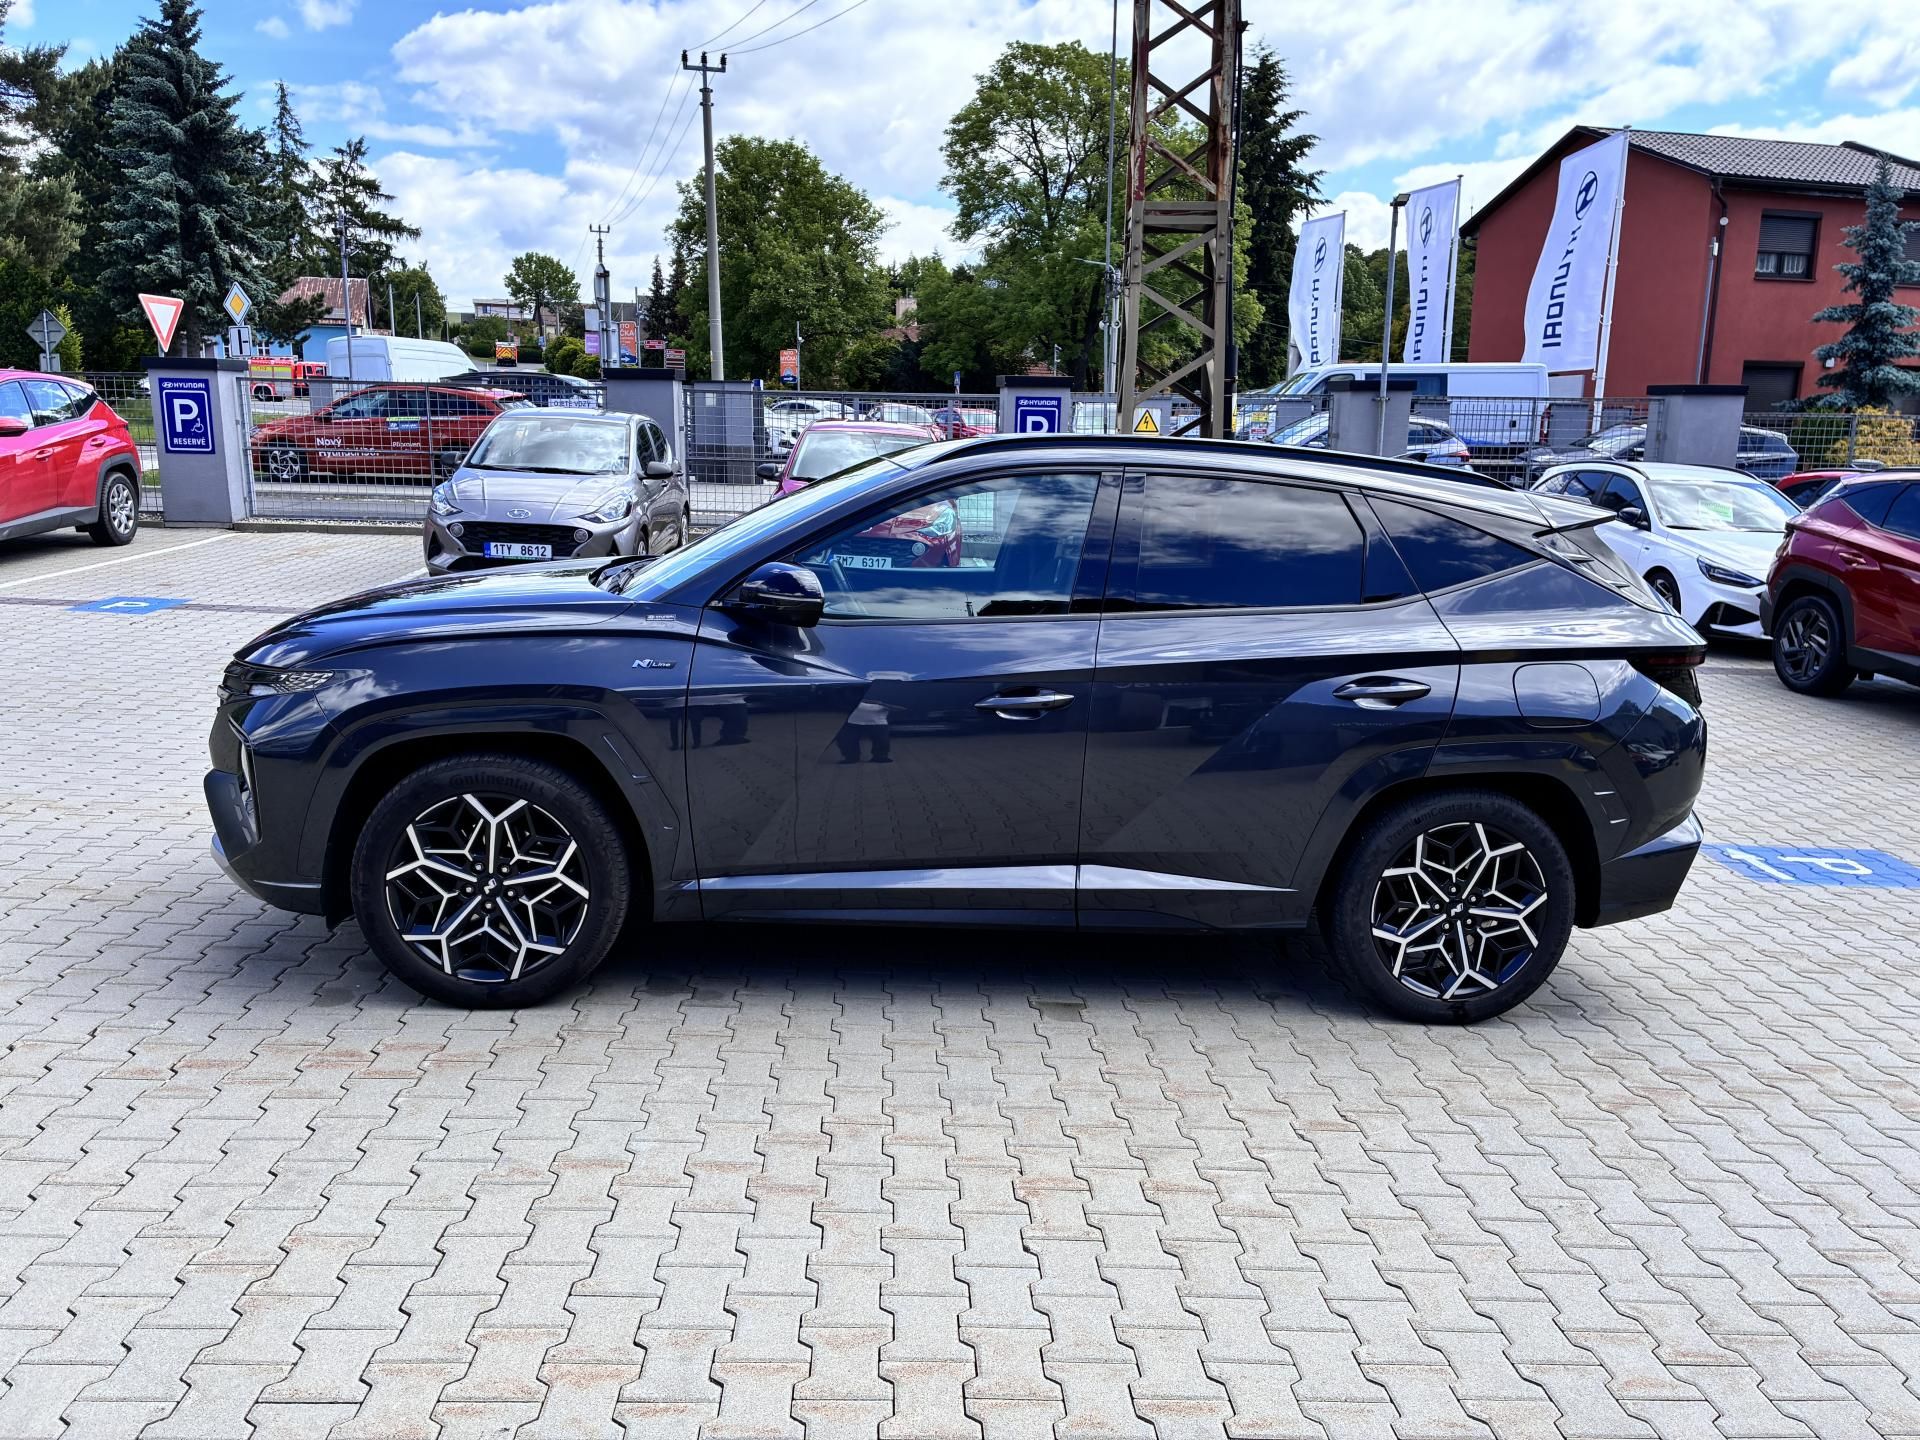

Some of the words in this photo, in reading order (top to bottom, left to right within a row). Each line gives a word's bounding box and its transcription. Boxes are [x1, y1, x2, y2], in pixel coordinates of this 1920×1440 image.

[1542, 225, 1582, 348] HYUNDAI
[173, 398, 199, 433] P
[316, 436, 342, 447] Nový
[493, 543, 512, 556] 1TY
[520, 545, 547, 557] 8612
[862, 557, 887, 568] 6317
